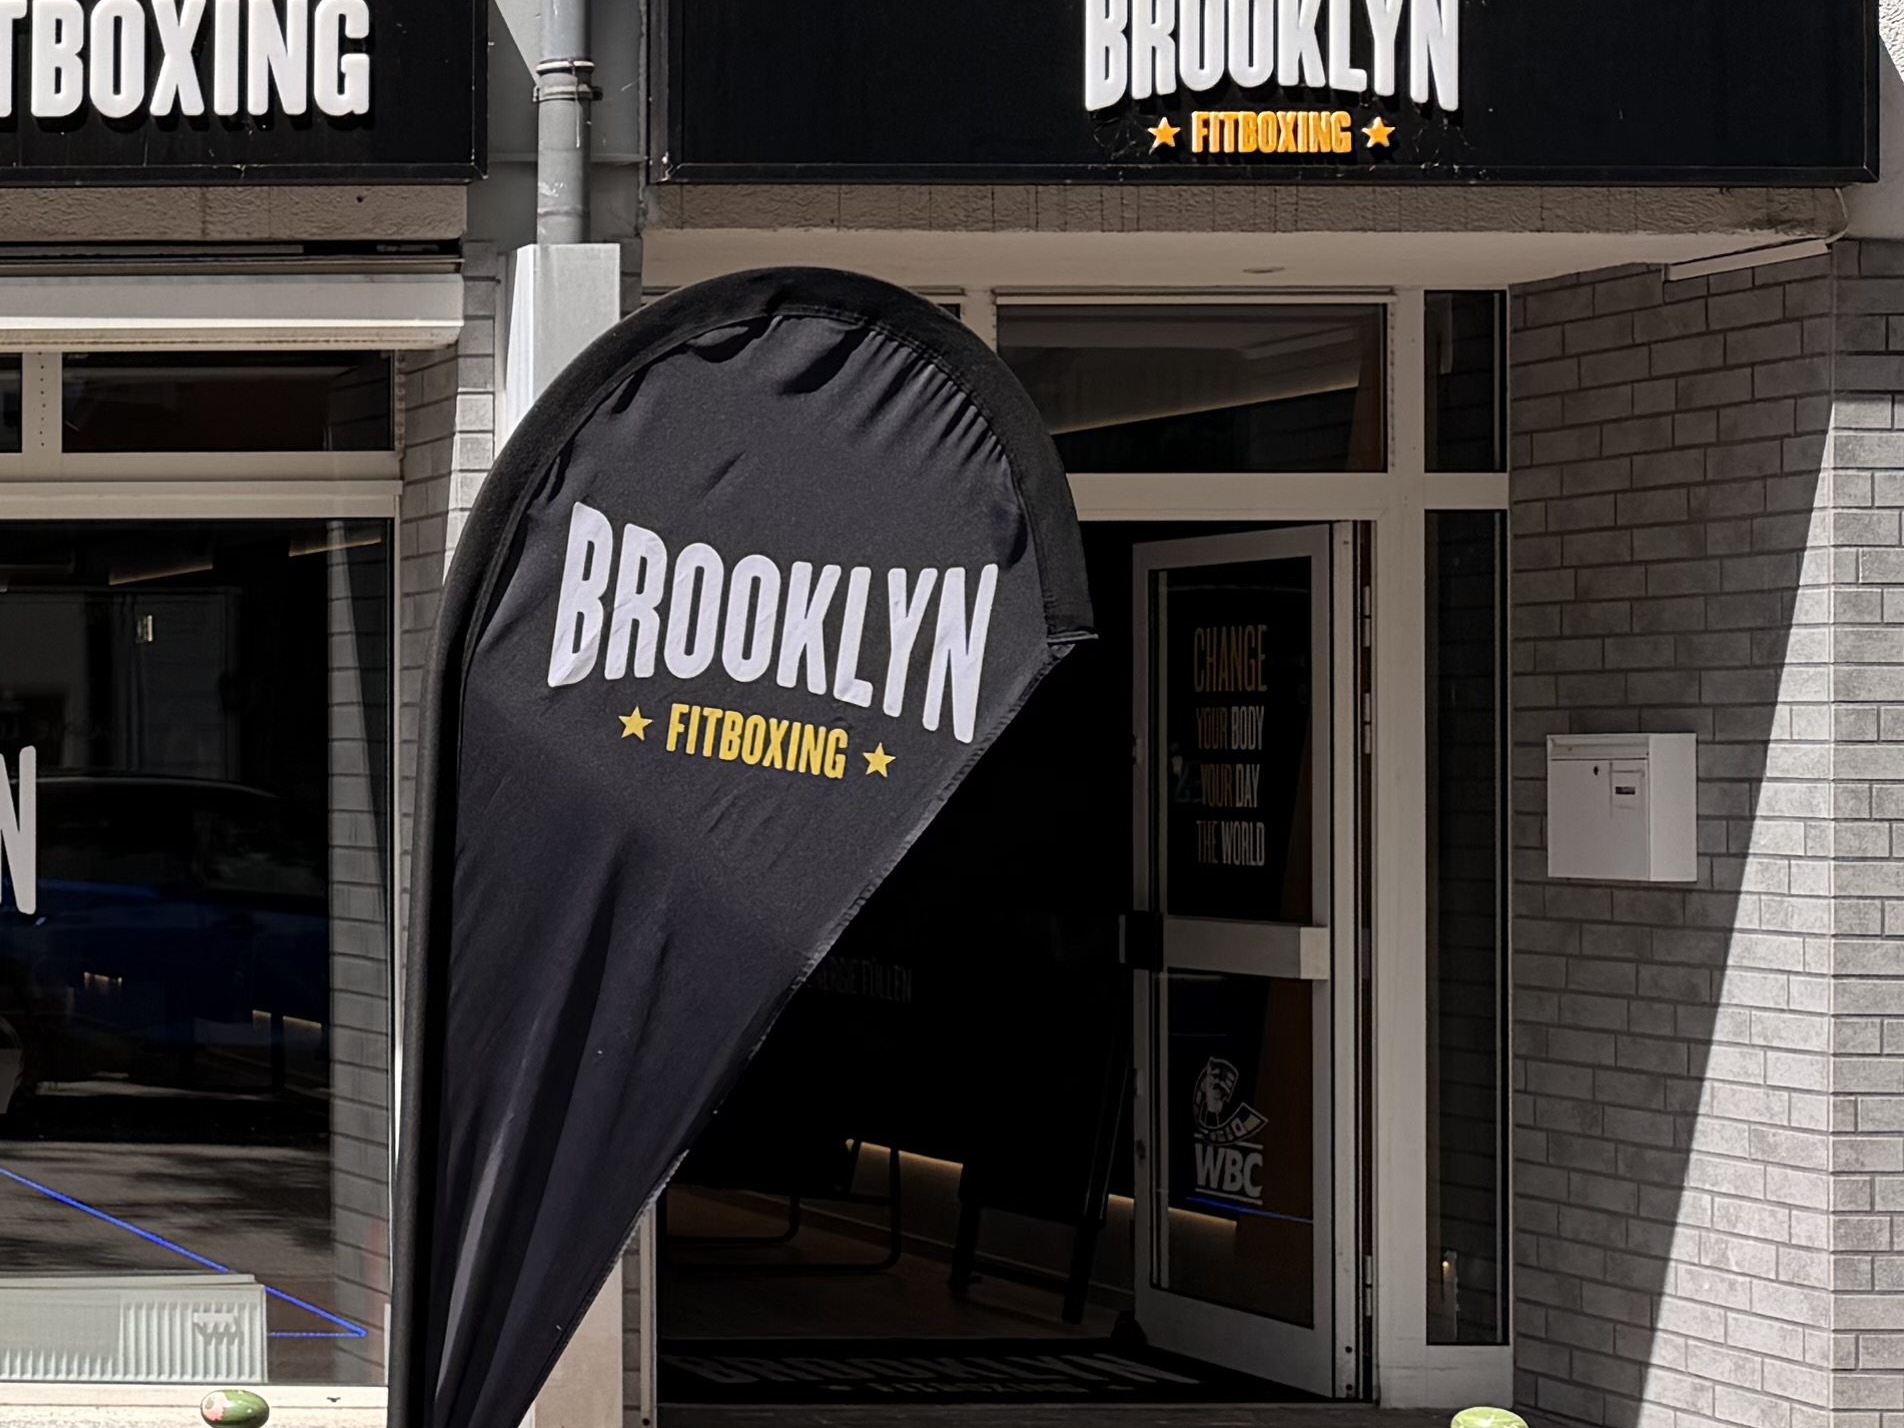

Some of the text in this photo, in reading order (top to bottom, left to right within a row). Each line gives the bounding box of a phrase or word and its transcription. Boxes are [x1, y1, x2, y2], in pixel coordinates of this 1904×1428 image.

[1191, 110, 1352, 154] FITBOXING
[547, 500, 999, 744] BROOKLYN
[1193, 624, 1268, 693] CHANGE
[665, 702, 848, 780] FITBOXING
[1196, 705, 1265, 750] YOUR BODY
[1200, 763, 1261, 808] YOUR DAY
[1196, 820, 1267, 866] THE WORLD
[1194, 1143, 1264, 1198] WBC
